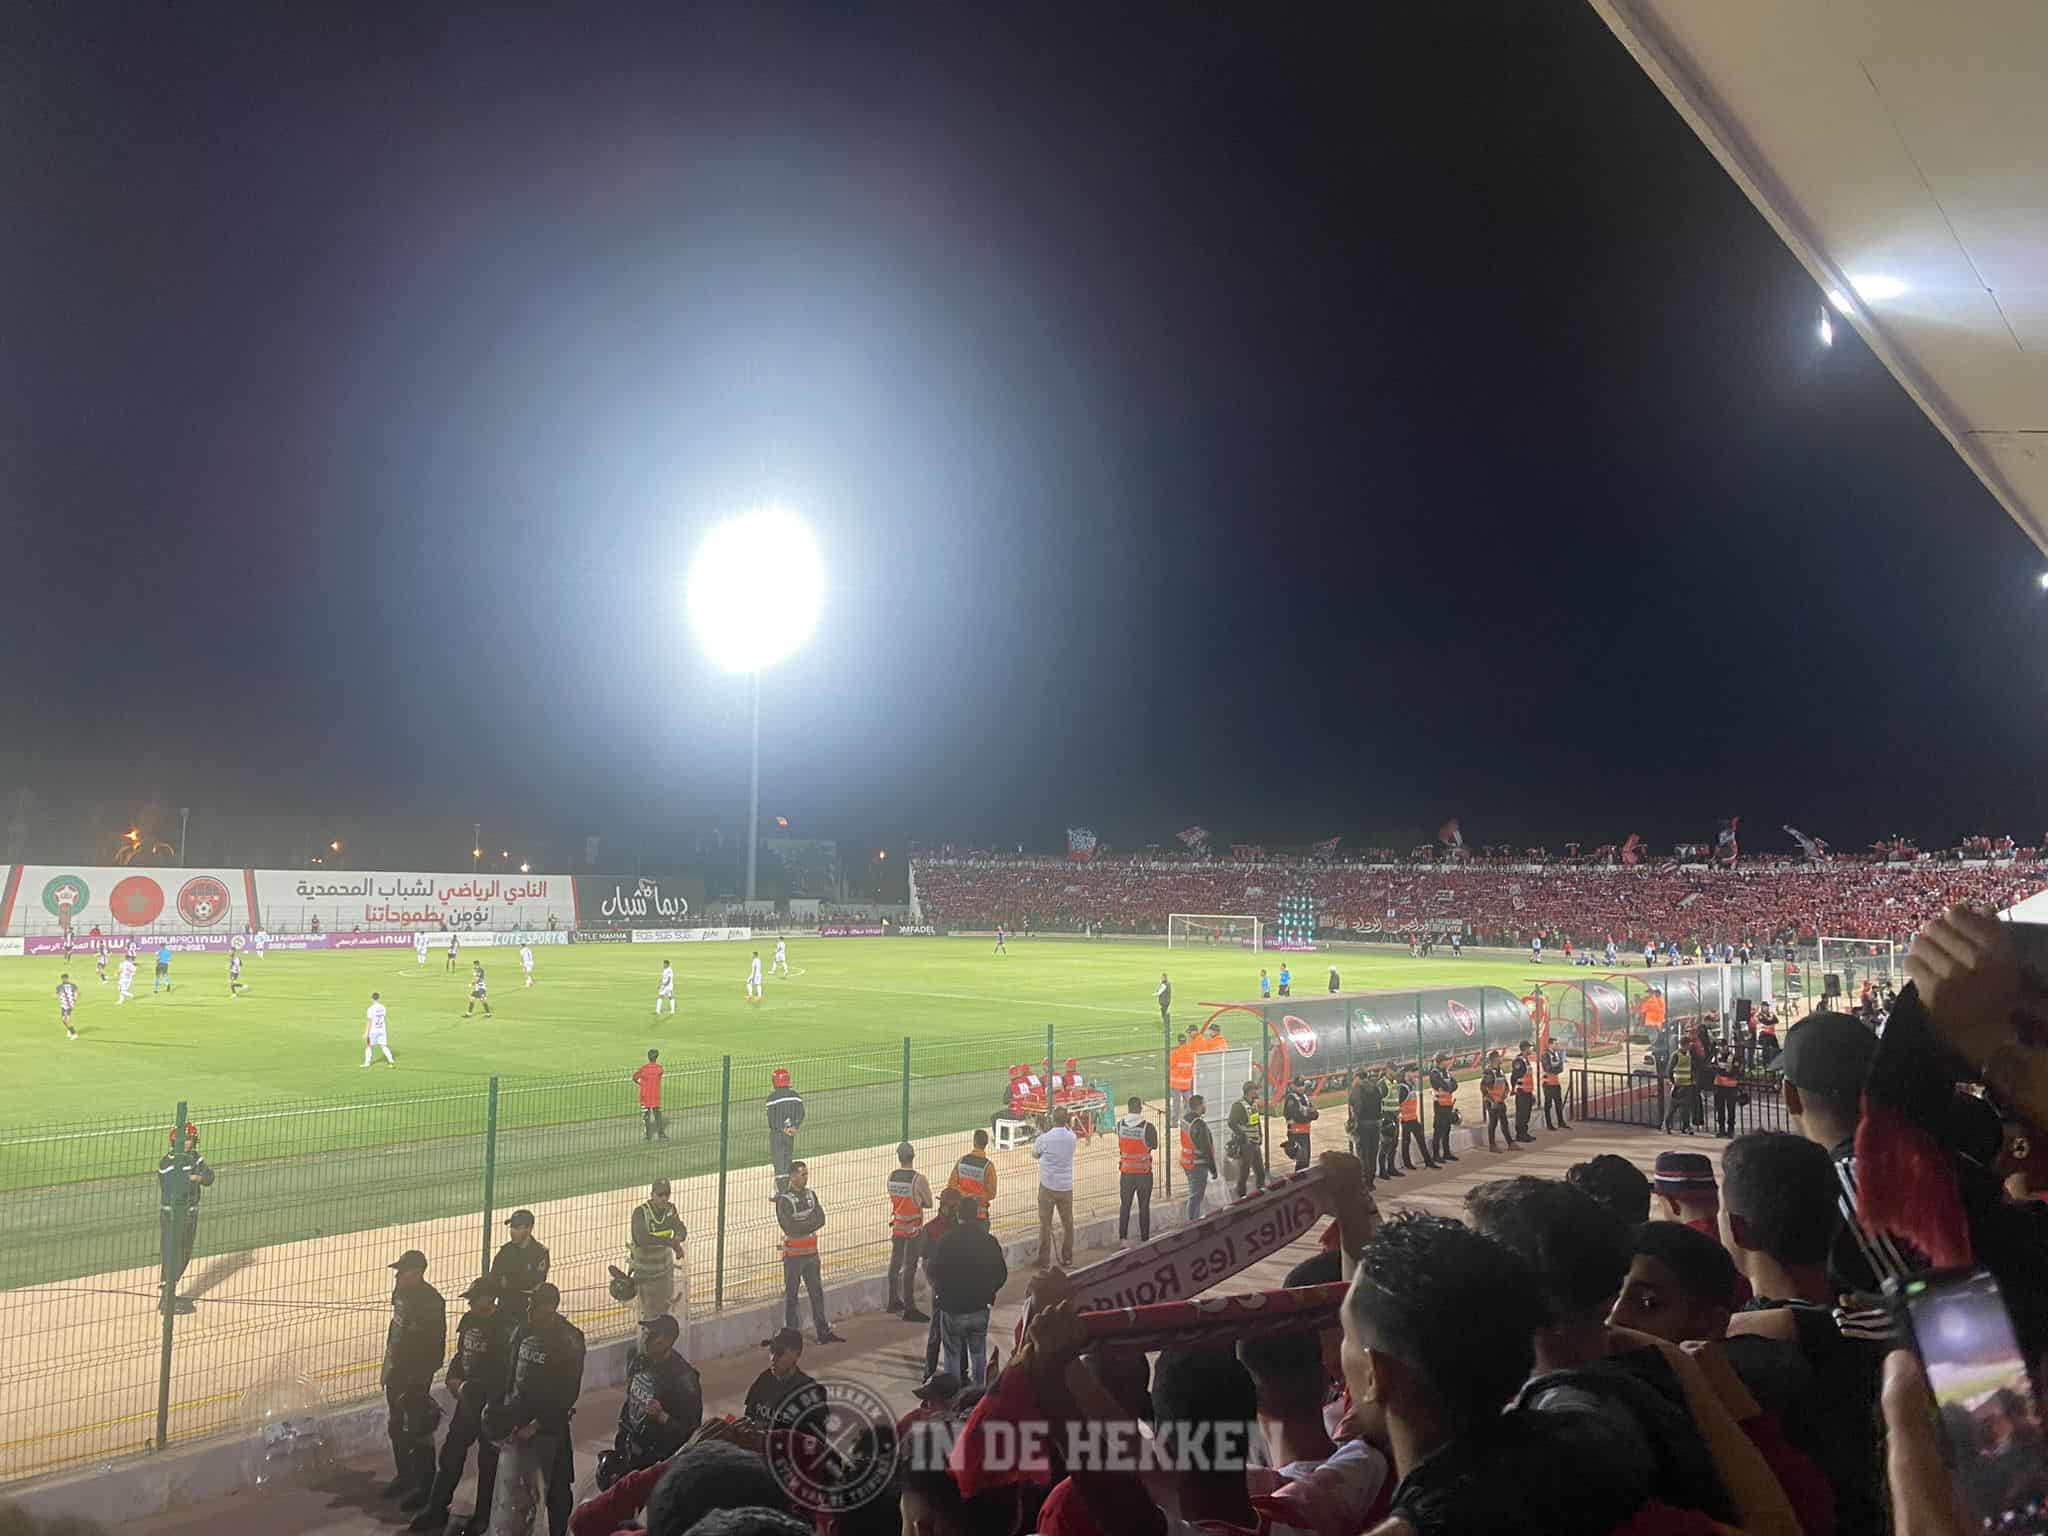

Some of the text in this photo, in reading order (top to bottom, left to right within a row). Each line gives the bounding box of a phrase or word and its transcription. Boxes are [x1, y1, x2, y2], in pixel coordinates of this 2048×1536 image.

[296, 877, 547, 905] النادي الرياضي لشباب المحمدية
[365, 903, 489, 928] نؤمن بطموحاتنا
[756, 1403, 790, 1424] POLICE
